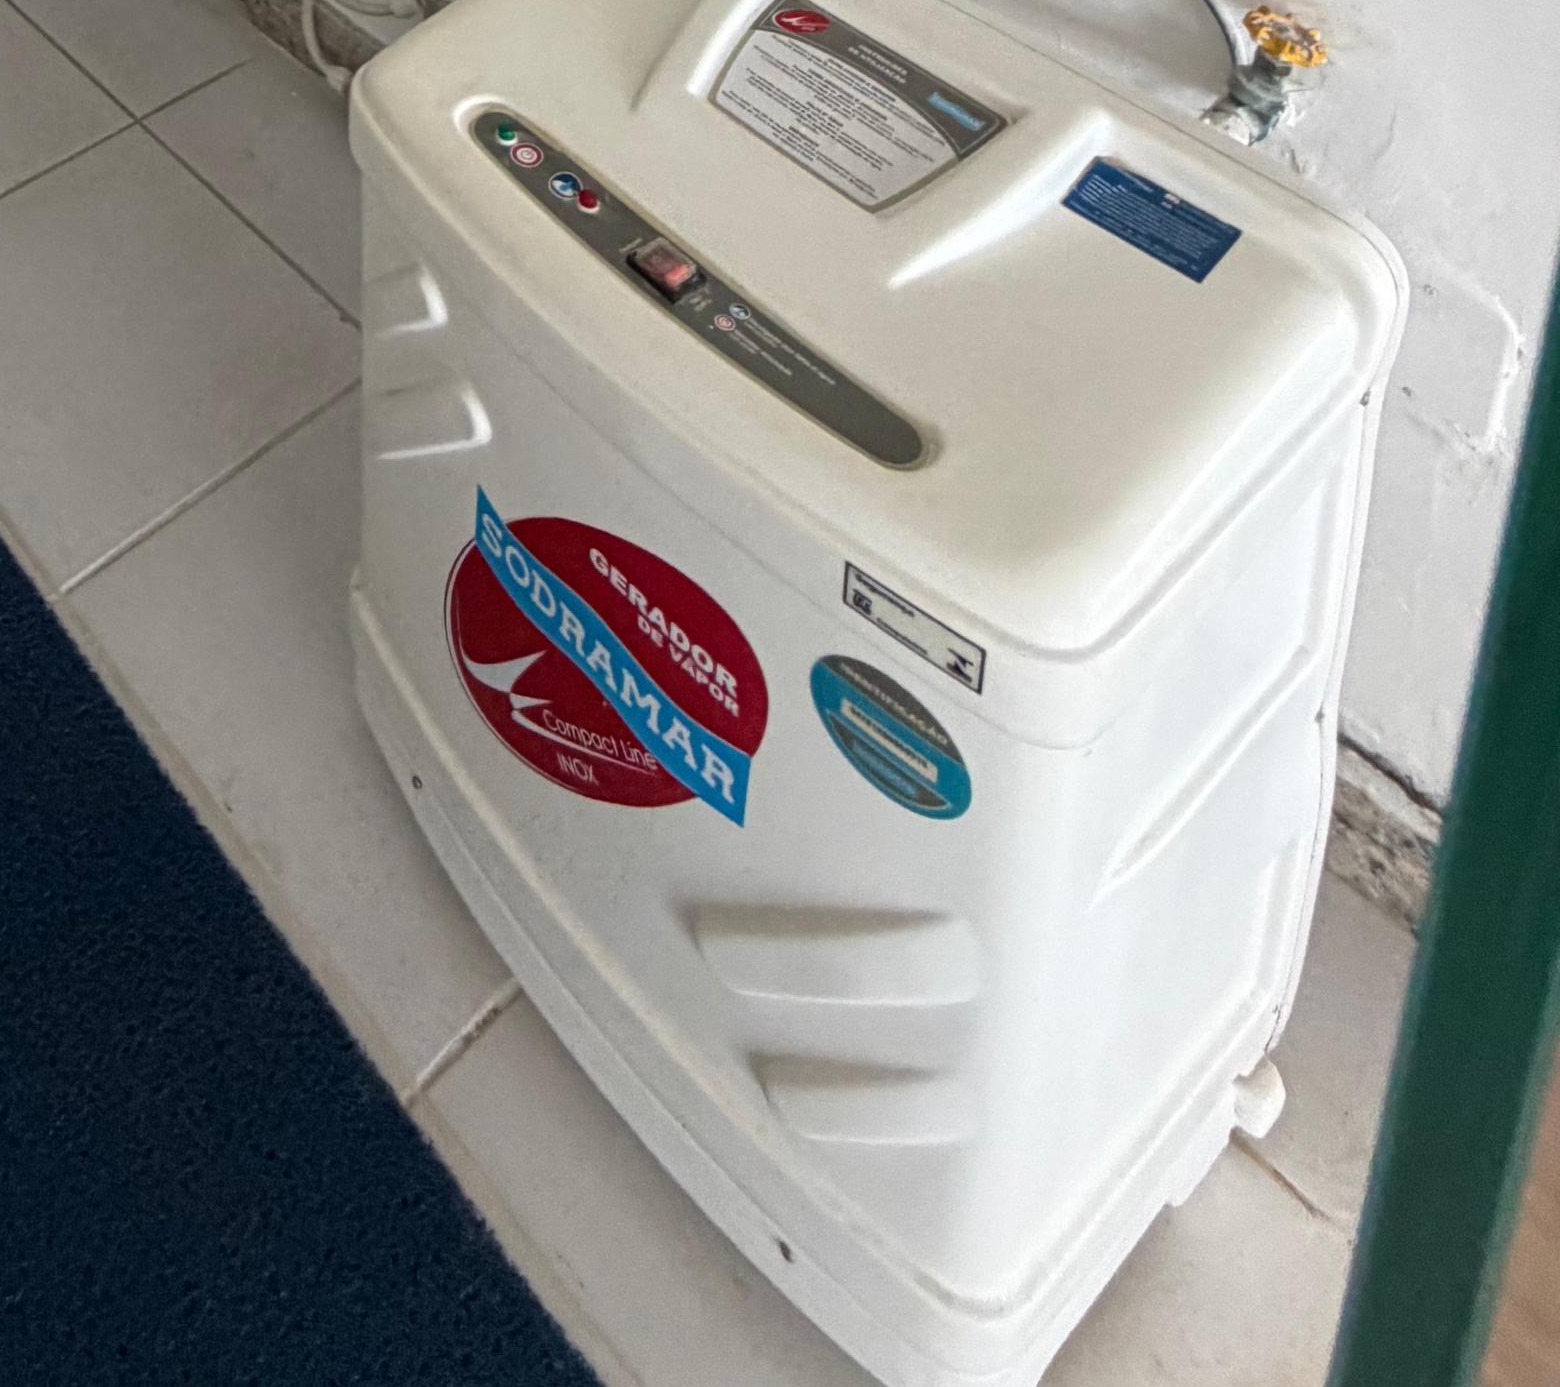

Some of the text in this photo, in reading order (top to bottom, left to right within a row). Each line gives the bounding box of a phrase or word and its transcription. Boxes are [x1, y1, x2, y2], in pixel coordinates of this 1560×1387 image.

[481, 513, 736, 805] SODRAMAR
[589, 547, 738, 698] GERADOR
[637, 613, 740, 717] DE VAPOR
[541, 708, 658, 771] Compact Line
[555, 752, 600, 786] INOX
